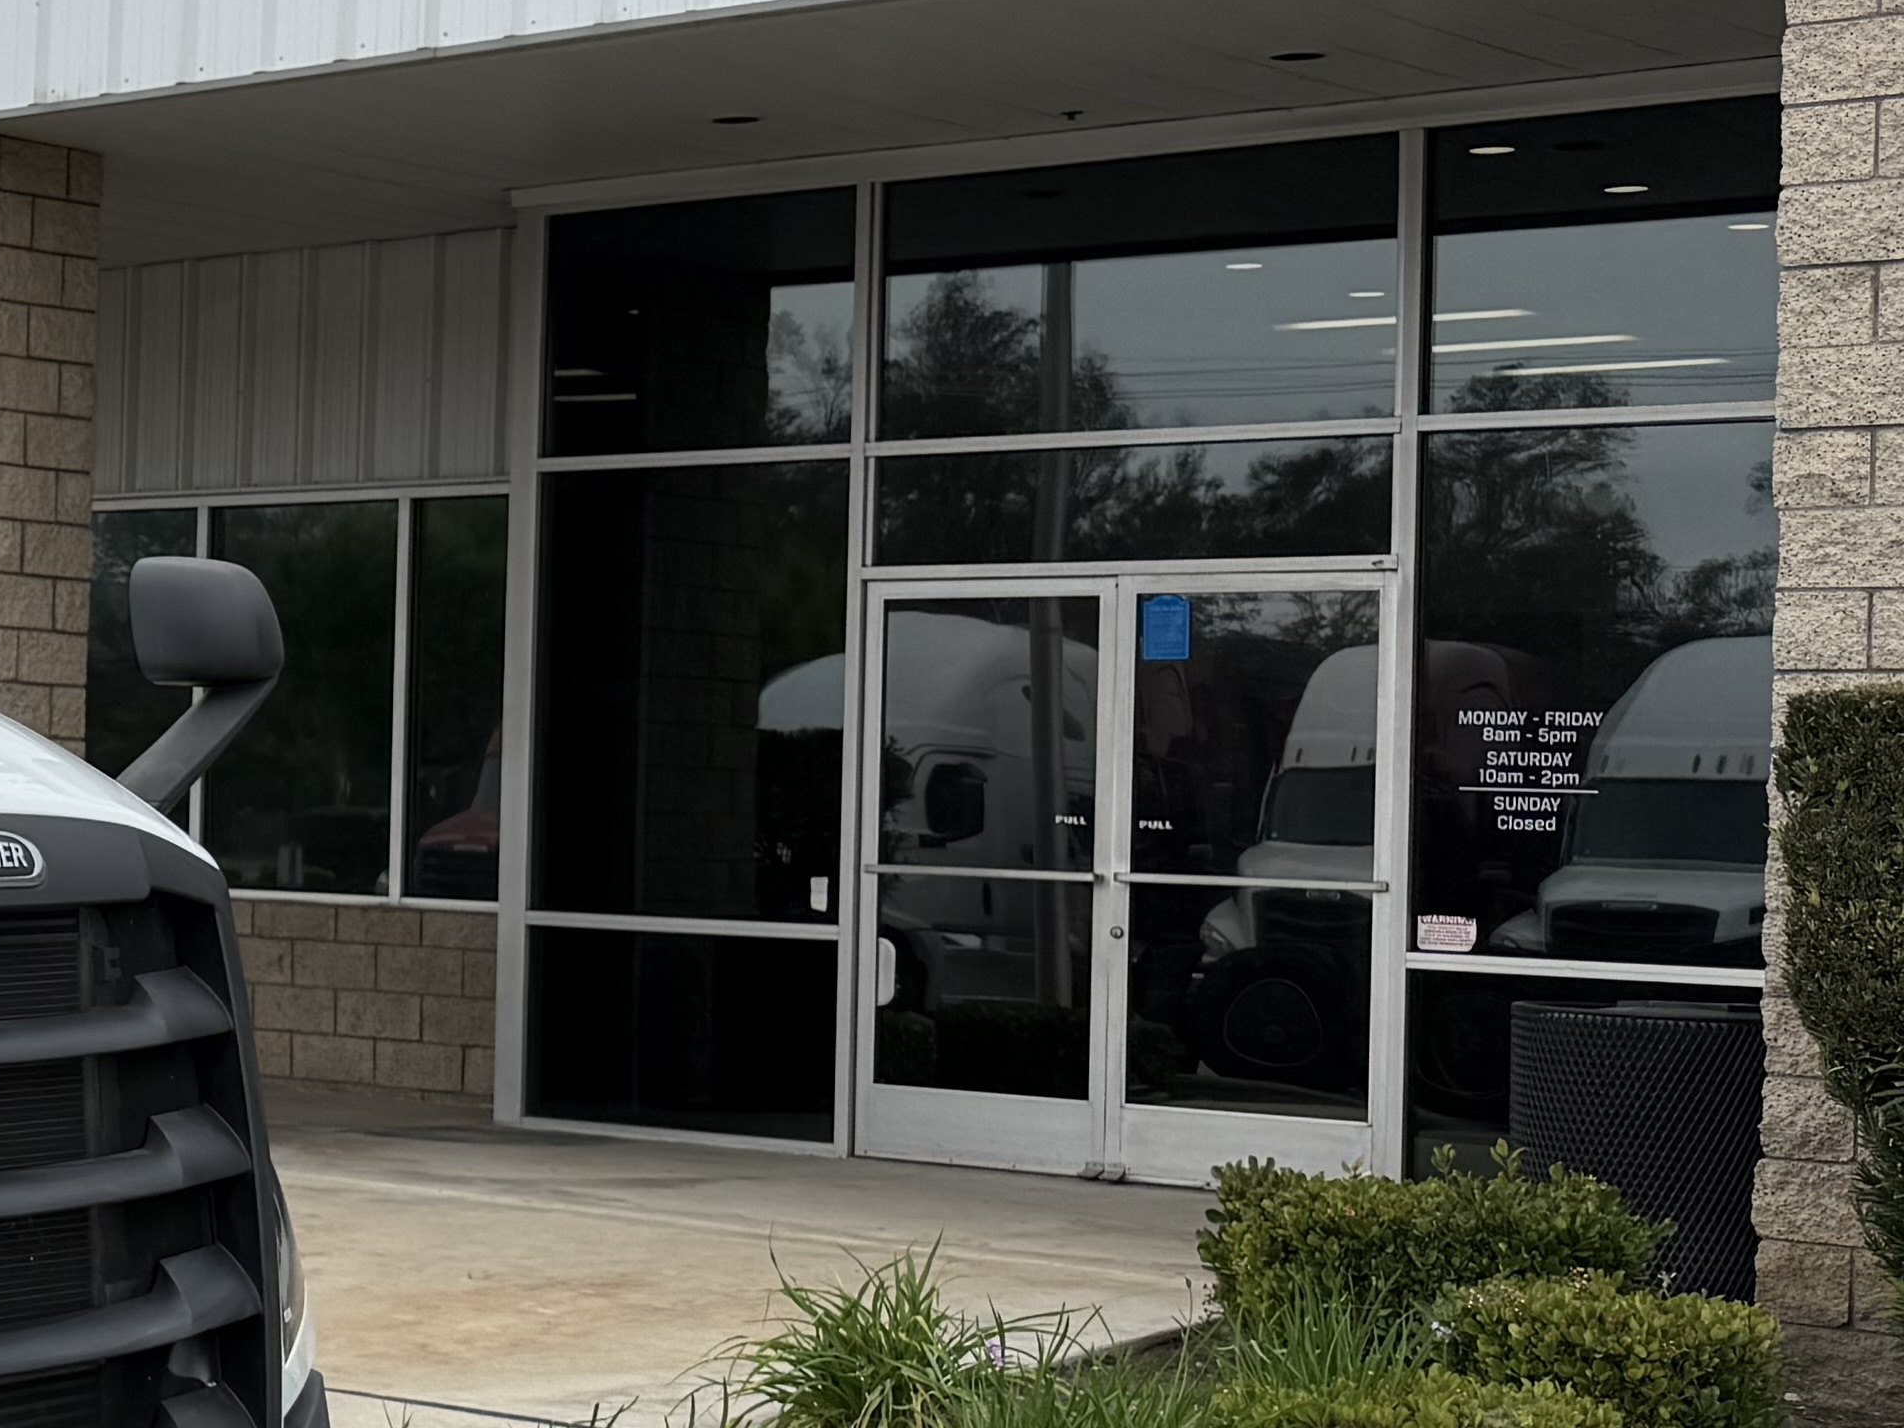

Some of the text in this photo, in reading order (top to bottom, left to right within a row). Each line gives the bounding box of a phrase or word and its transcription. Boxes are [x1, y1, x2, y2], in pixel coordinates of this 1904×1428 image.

[1458, 710, 1527, 726] MONDAY
[1544, 711, 1603, 727] FRIDAY
[1482, 727, 1521, 742] 8am
[1538, 727, 1577, 745] 5pm
[1486, 751, 1572, 767] SATURDAY
[1479, 768, 1524, 784] 10am
[1540, 770, 1579, 788] 2pm
[1493, 796, 1561, 812] SUNDAY
[1055, 815, 1088, 826] PULL
[1138, 819, 1174, 830] PULL
[1497, 815, 1556, 831] Closed
